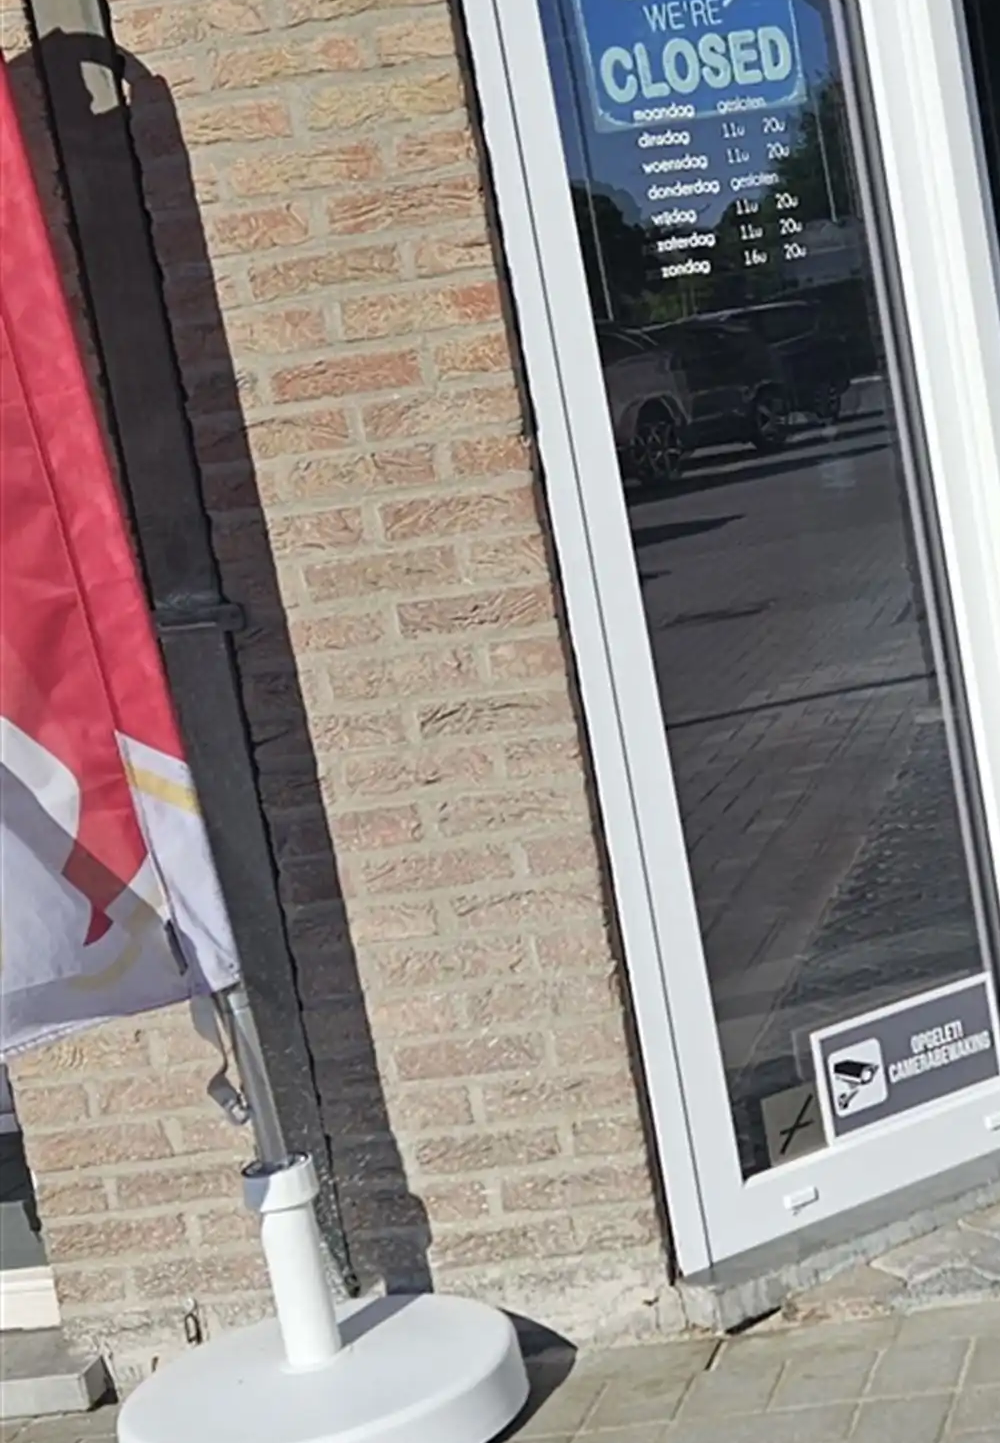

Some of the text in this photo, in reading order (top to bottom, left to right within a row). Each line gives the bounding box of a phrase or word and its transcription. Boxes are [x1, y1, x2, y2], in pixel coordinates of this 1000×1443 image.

[600, 26, 791, 103] CLOSED
[633, 102, 695, 121] maandag
[642, 154, 708, 174] woensdag
[648, 171, 779, 200] donderdag gesloten
[651, 207, 698, 226] vrijdag
[656, 231, 716, 253] zaterdag
[660, 259, 711, 279] zondag
[910, 1020, 964, 1054] OPGELET!
[888, 1030, 991, 1084] CAMERABEWAKING
